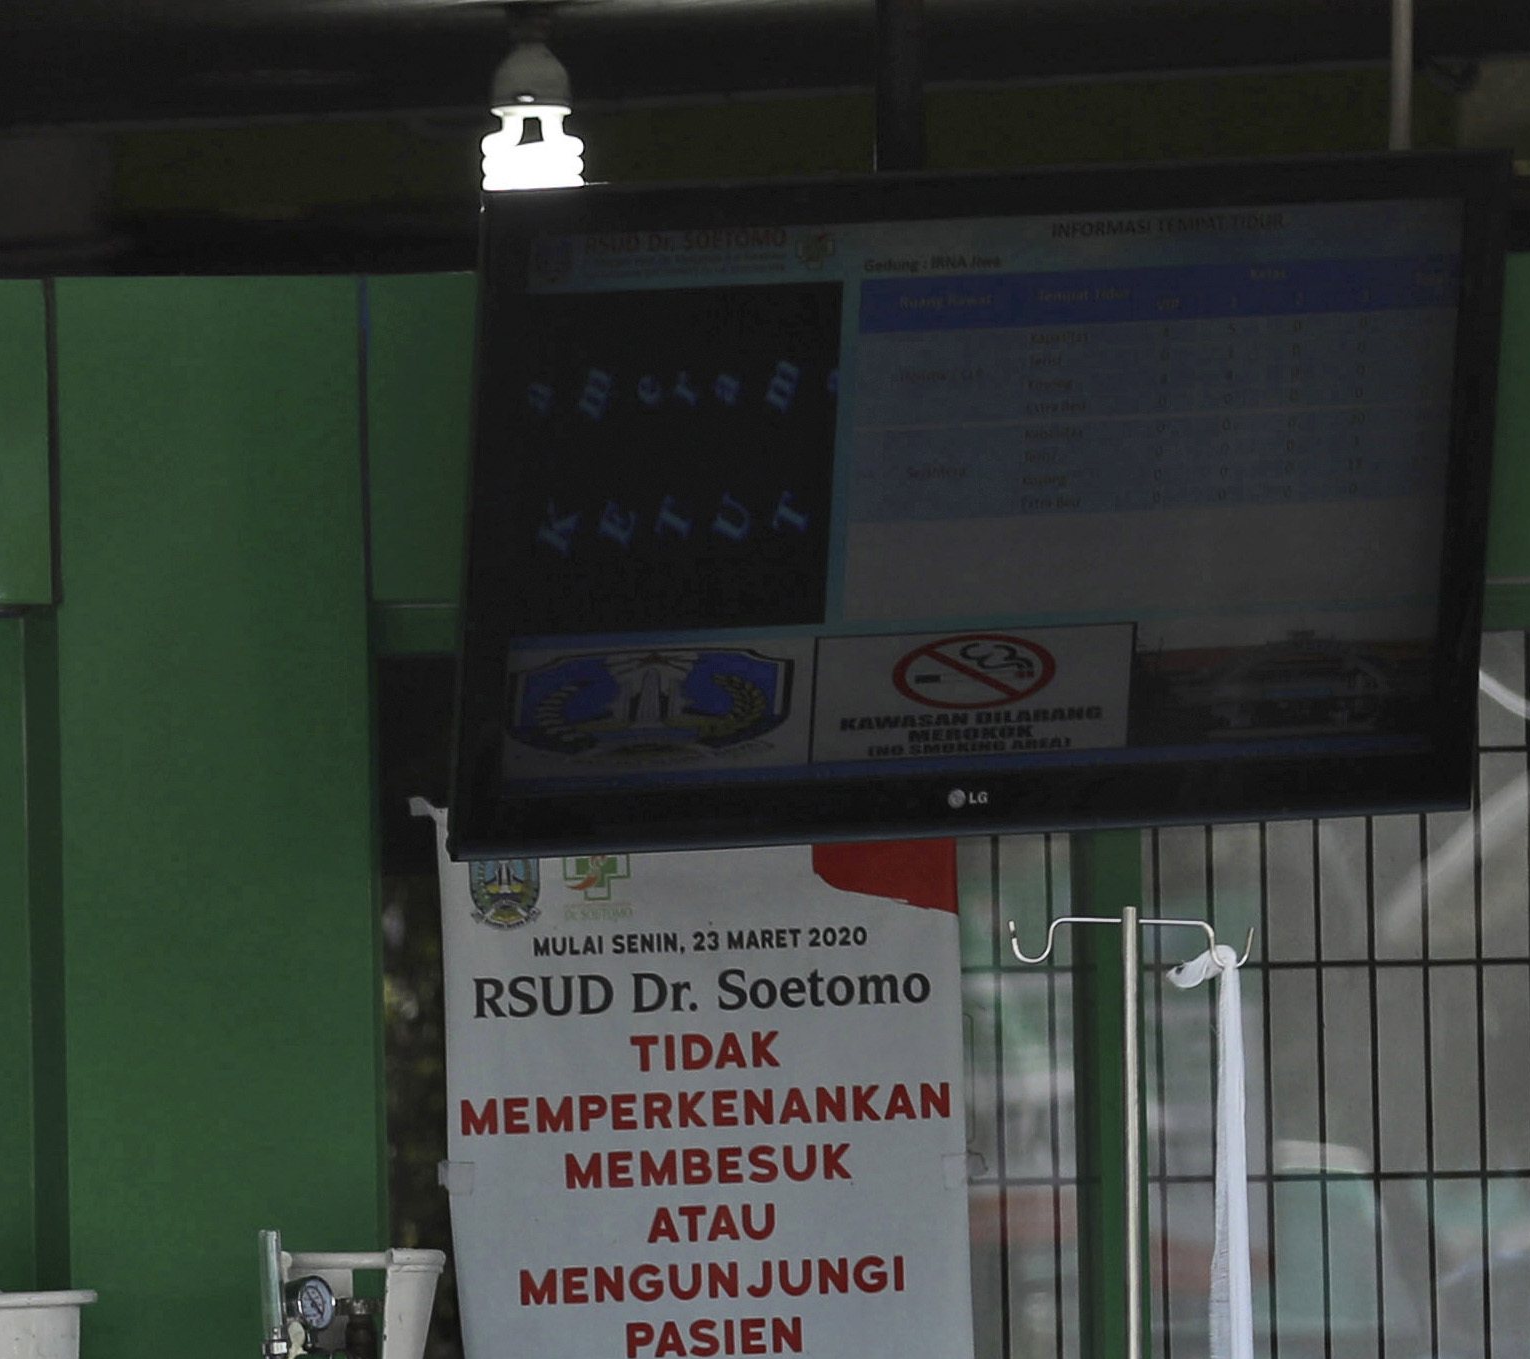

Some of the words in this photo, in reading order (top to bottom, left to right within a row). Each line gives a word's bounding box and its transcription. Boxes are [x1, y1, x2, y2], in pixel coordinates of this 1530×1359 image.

[840, 711, 968, 732] KAWASAN
[975, 705, 1104, 727] DILARANG
[908, 724, 1034, 743] MEROKOK
[910, 739, 1006, 756] SMOKING
[968, 791, 989, 805] LG
[533, 935, 604, 957] MULAI
[611, 932, 686, 955] SENIN,
[692, 930, 720, 952] 23
[726, 928, 802, 950] MARET
[808, 926, 868, 948] 2020
[473, 974, 614, 1019] RSUD
[631, 972, 698, 1014] Dr.
[717, 968, 931, 1011] Soetomo
[632, 1032, 777, 1071] TIDAK
[461, 1084, 950, 1134] MEMPERKENANKAN
[566, 1145, 849, 1188] MEMBESUK
[650, 1205, 775, 1242] ATAU
[521, 1257, 904, 1304] MENGUNJUNGI
[628, 1318, 802, 1358] PASIEN
